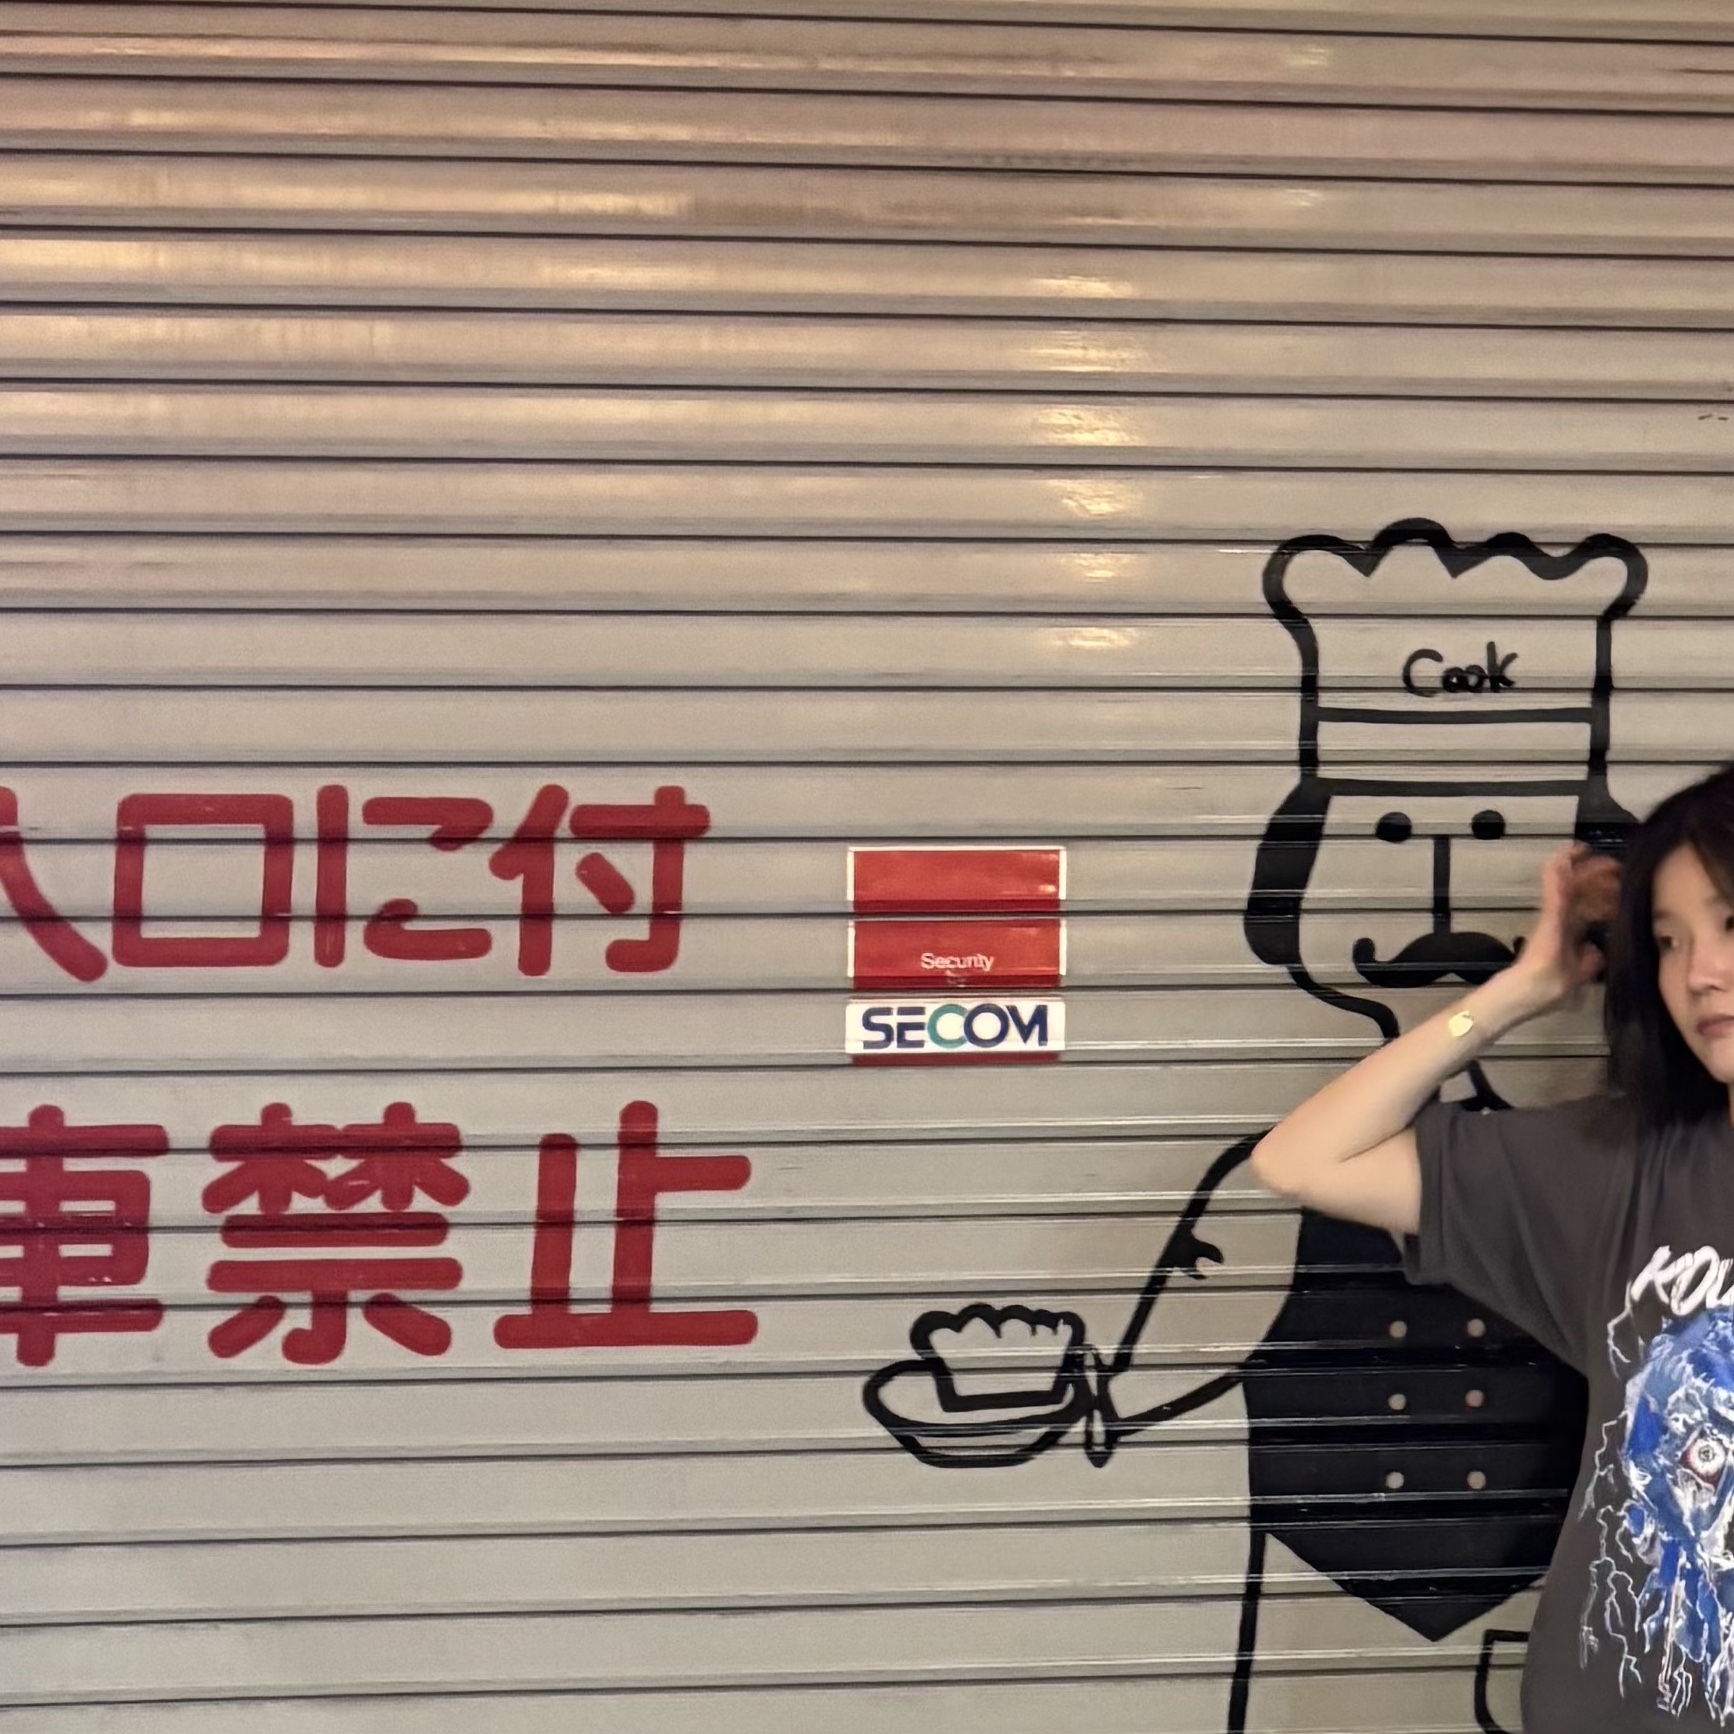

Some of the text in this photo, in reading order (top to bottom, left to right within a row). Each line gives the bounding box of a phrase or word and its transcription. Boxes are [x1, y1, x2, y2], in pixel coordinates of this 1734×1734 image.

[1402, 641, 1518, 697] Cook
[921, 952, 994, 972] Security
[862, 1003, 1048, 1050] SECOM
